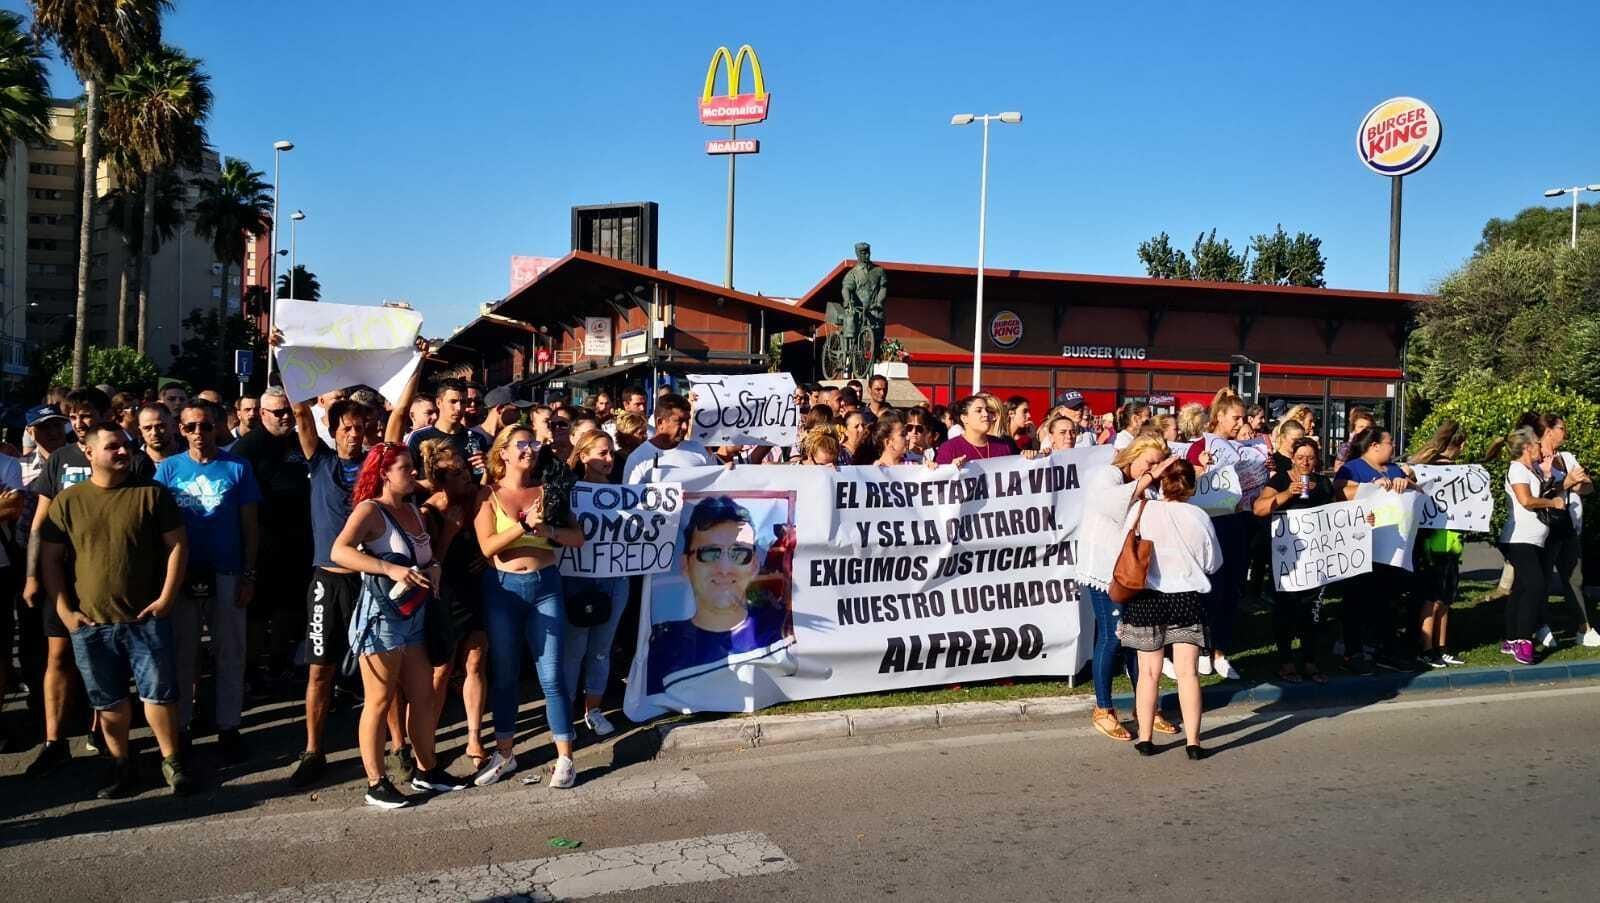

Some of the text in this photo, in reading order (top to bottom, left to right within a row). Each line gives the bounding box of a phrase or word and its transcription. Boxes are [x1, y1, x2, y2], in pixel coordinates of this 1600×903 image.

[703, 104, 764, 118] McDonald's
[1368, 107, 1426, 140] BURGER
[1369, 120, 1428, 160] KING
[994, 327, 1020, 337] KING
[1062, 345, 1146, 360] BURGER KING
[570, 486, 679, 512] TODOS
[836, 481, 859, 509] EL
[995, 471, 1022, 498] LA
[1028, 464, 1080, 494] VIDA
[1194, 470, 1231, 496] DOS
[579, 512, 665, 542] OMOS
[857, 505, 1063, 548] Y SE LA QUITARON.
[1273, 505, 1365, 538] JUSTICIA
[559, 541, 675, 574] ALFREDO
[1293, 531, 1346, 562] PARA
[810, 540, 1078, 587] EXIGIMOS JUSTICIA PA
[1278, 549, 1365, 590] ALFREDO
[837, 590, 945, 626] NUESTRO
[309, 604, 324, 656] adidas
[878, 623, 1047, 674] ALFREDO.
